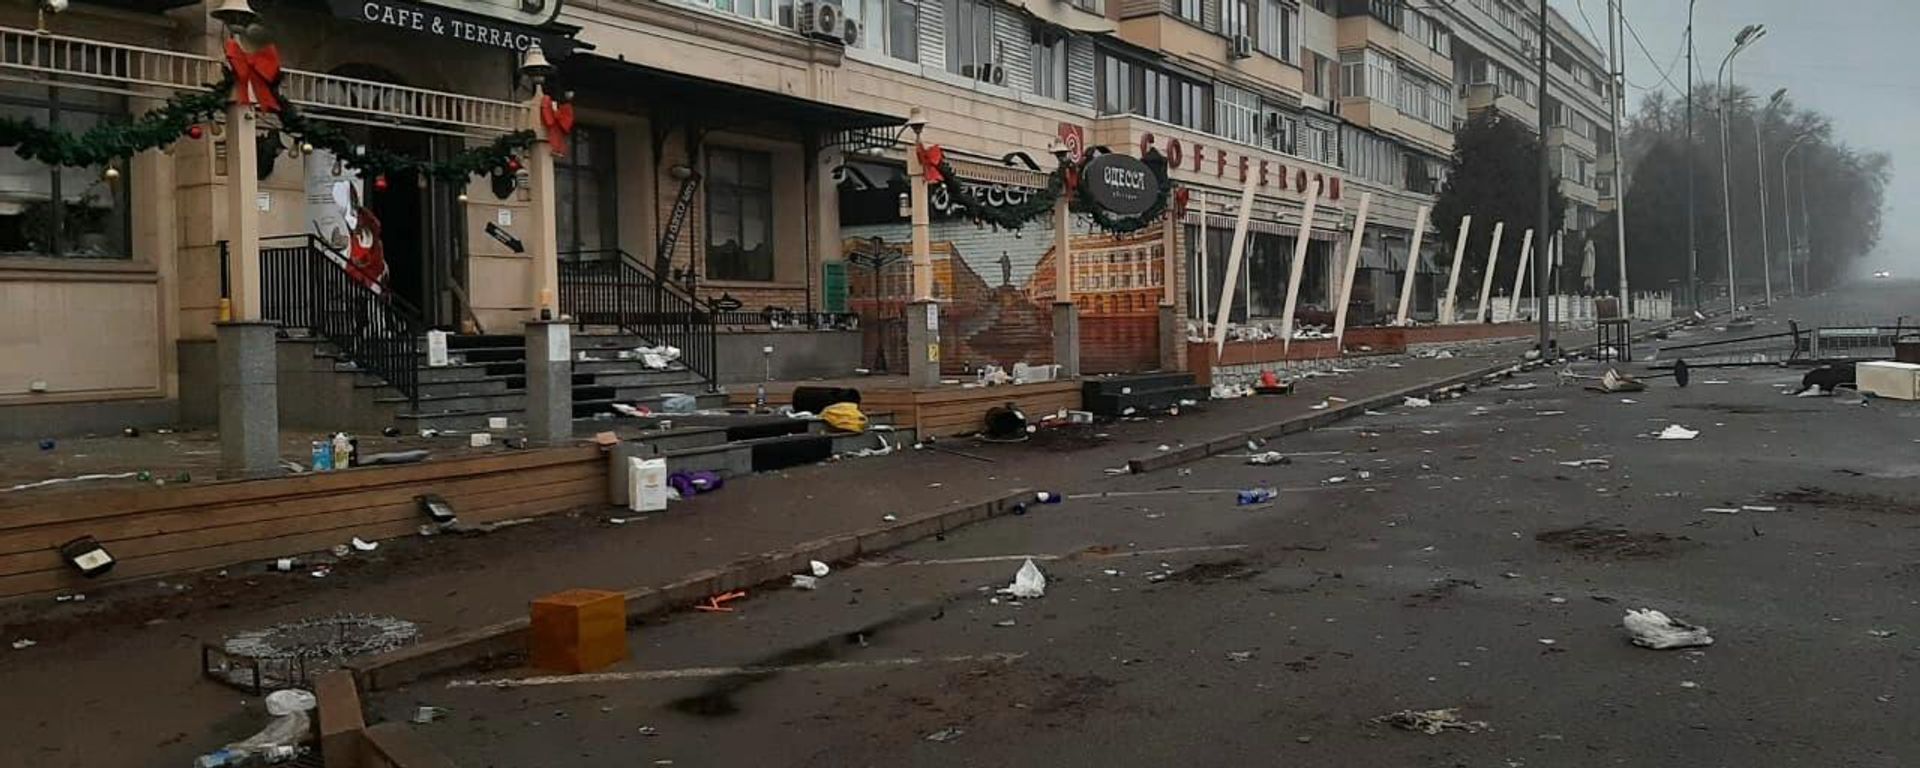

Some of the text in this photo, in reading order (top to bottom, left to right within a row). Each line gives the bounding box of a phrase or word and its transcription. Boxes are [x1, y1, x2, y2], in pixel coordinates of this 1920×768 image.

[431, 16, 445, 35] &
[451, 20, 542, 50] TERRACE
[1104, 166, 1145, 191] ОДЕССА
